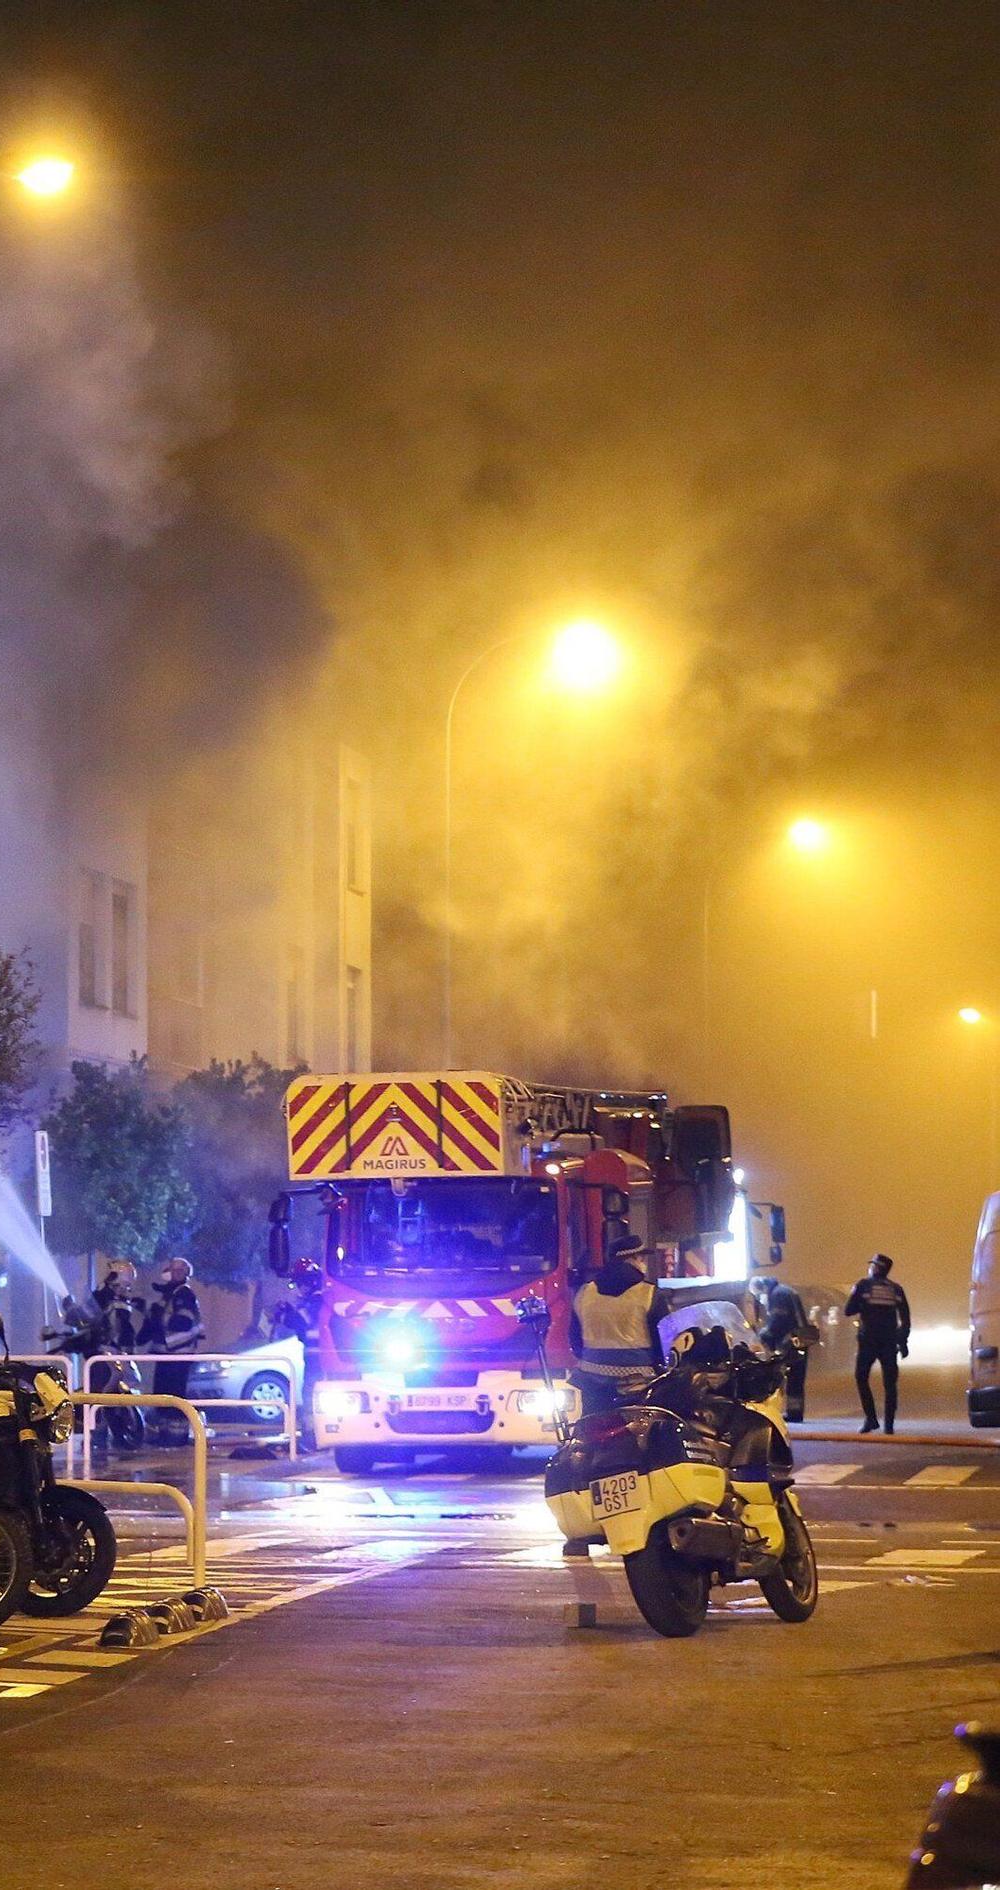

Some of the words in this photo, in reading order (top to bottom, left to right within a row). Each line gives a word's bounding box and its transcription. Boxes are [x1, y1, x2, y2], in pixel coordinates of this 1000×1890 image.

[363, 1159, 426, 1170] MAGIRUS
[603, 1475, 636, 1496] 4203
[604, 1492, 628, 1513] GST
